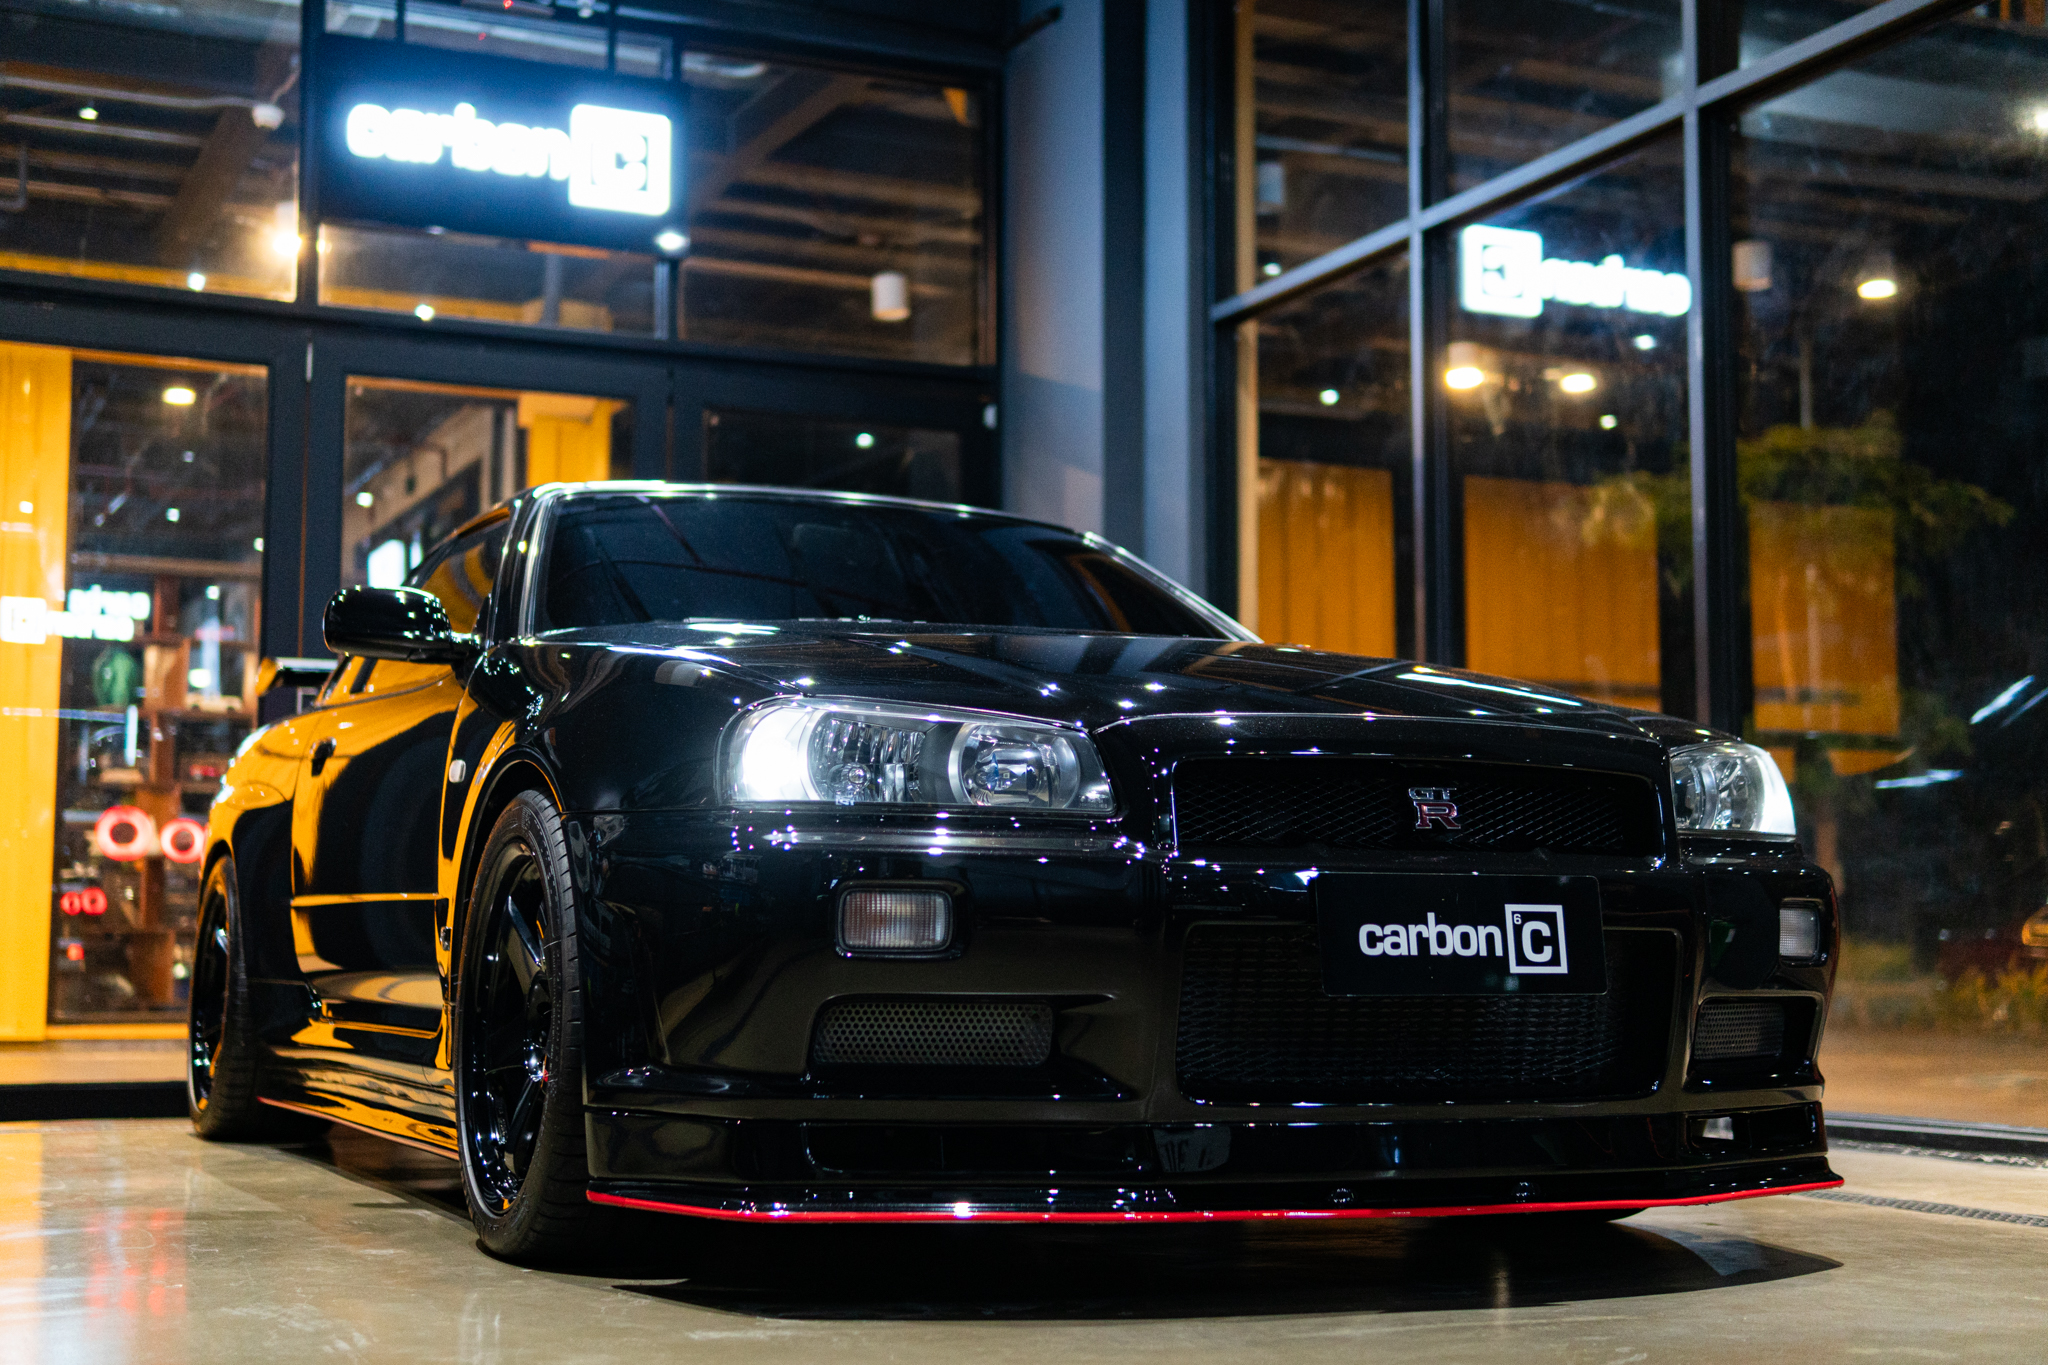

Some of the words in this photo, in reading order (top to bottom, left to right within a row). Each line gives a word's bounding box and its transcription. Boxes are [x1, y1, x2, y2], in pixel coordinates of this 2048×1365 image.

[346, 102, 571, 181] carbon
[1358, 912, 1503, 957] carbon
[1513, 913, 1522, 925] 6
[1521, 920, 1553, 963] C
